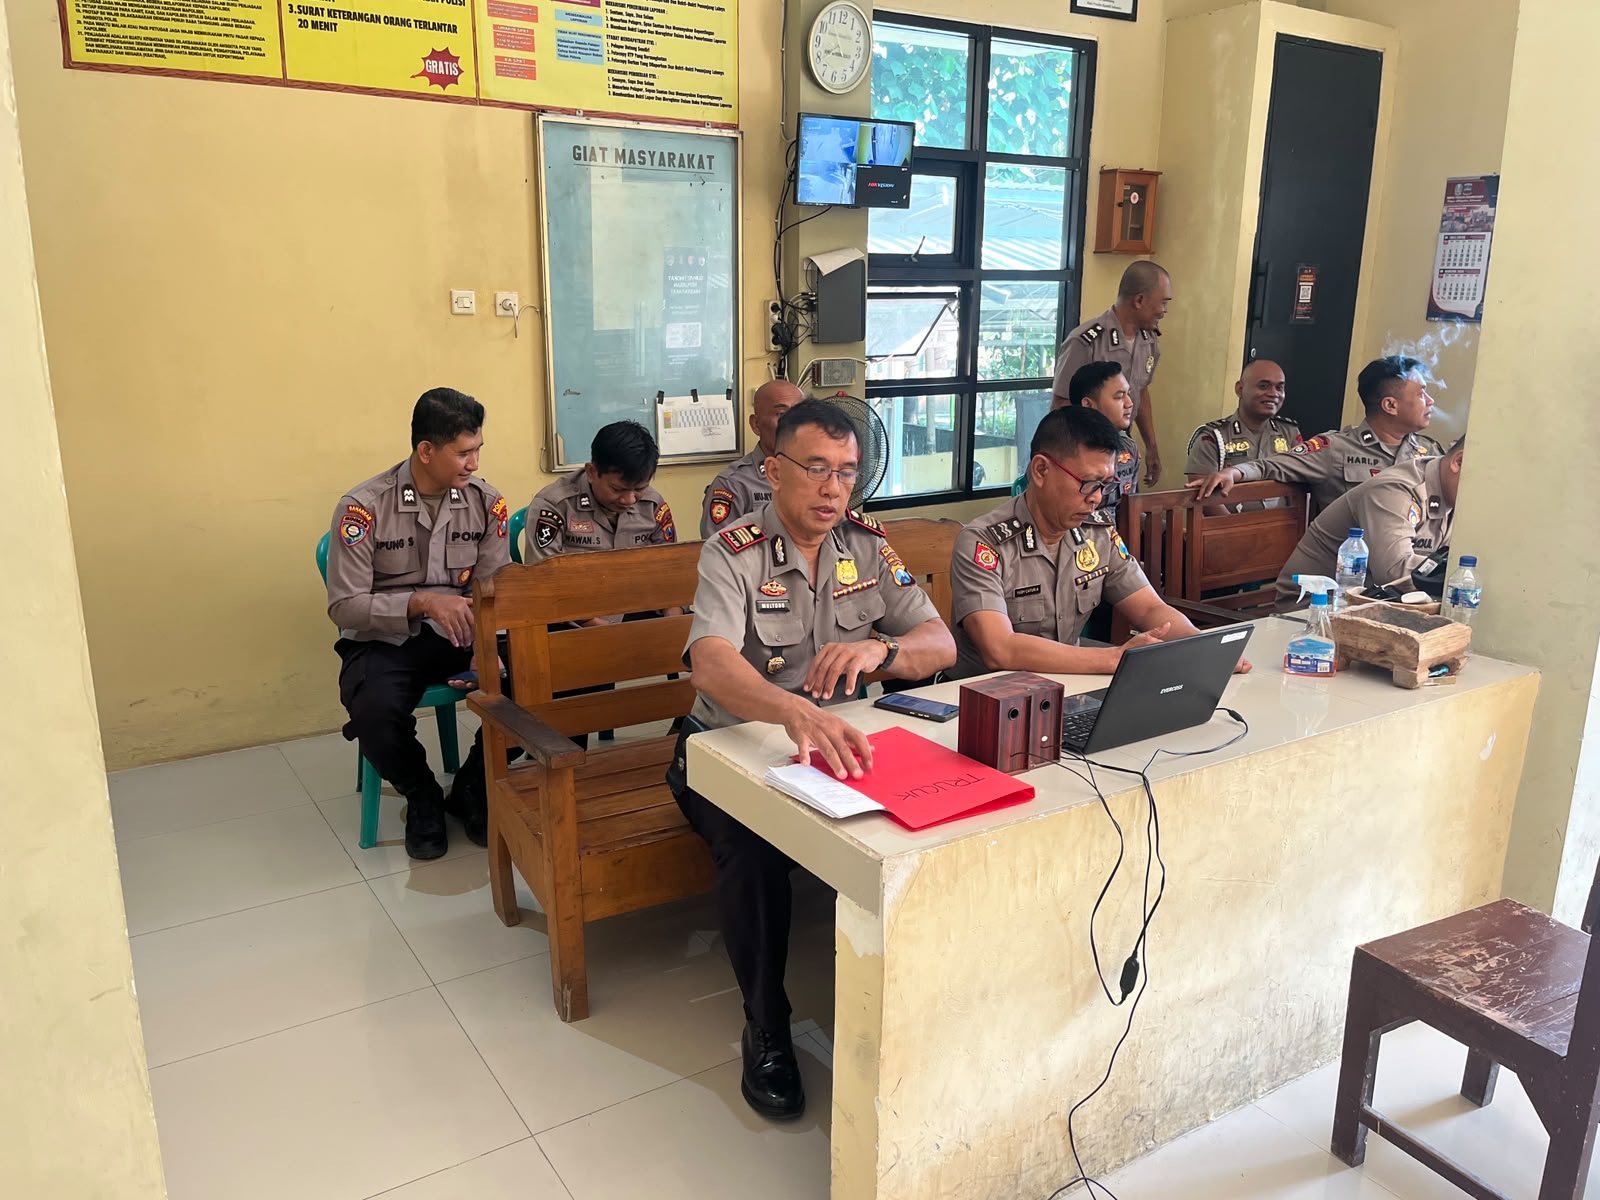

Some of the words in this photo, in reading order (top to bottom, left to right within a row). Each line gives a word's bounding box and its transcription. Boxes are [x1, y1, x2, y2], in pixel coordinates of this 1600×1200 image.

[327, 8, 381, 24] KETERANGAN
[383, 16, 412, 28] ORANG
[414, 19, 458, 34] TERLANTAR
[829, 12, 836, 24] 11
[839, 10, 848, 24] 12
[298, 19, 308, 28] 20
[311, 20, 338, 32] MENIT
[820, 20, 828, 34] 10
[851, 18, 855, 30] 1
[815, 35, 821, 48] 9
[856, 31, 861, 43] 2
[816, 51, 822, 64] 8
[855, 46, 861, 59] 3
[426, 60, 459, 76] GRATIS
[822, 64, 828, 77] 7
[850, 60, 855, 72] 4
[831, 70, 837, 83] 6
[841, 69, 846, 81] 5
[572, 145, 608, 163] GIAT
[615, 148, 714, 170] MASYARAKAT
[408, 537, 414, 546] S
[894, 773, 985, 801] TRUCUK
